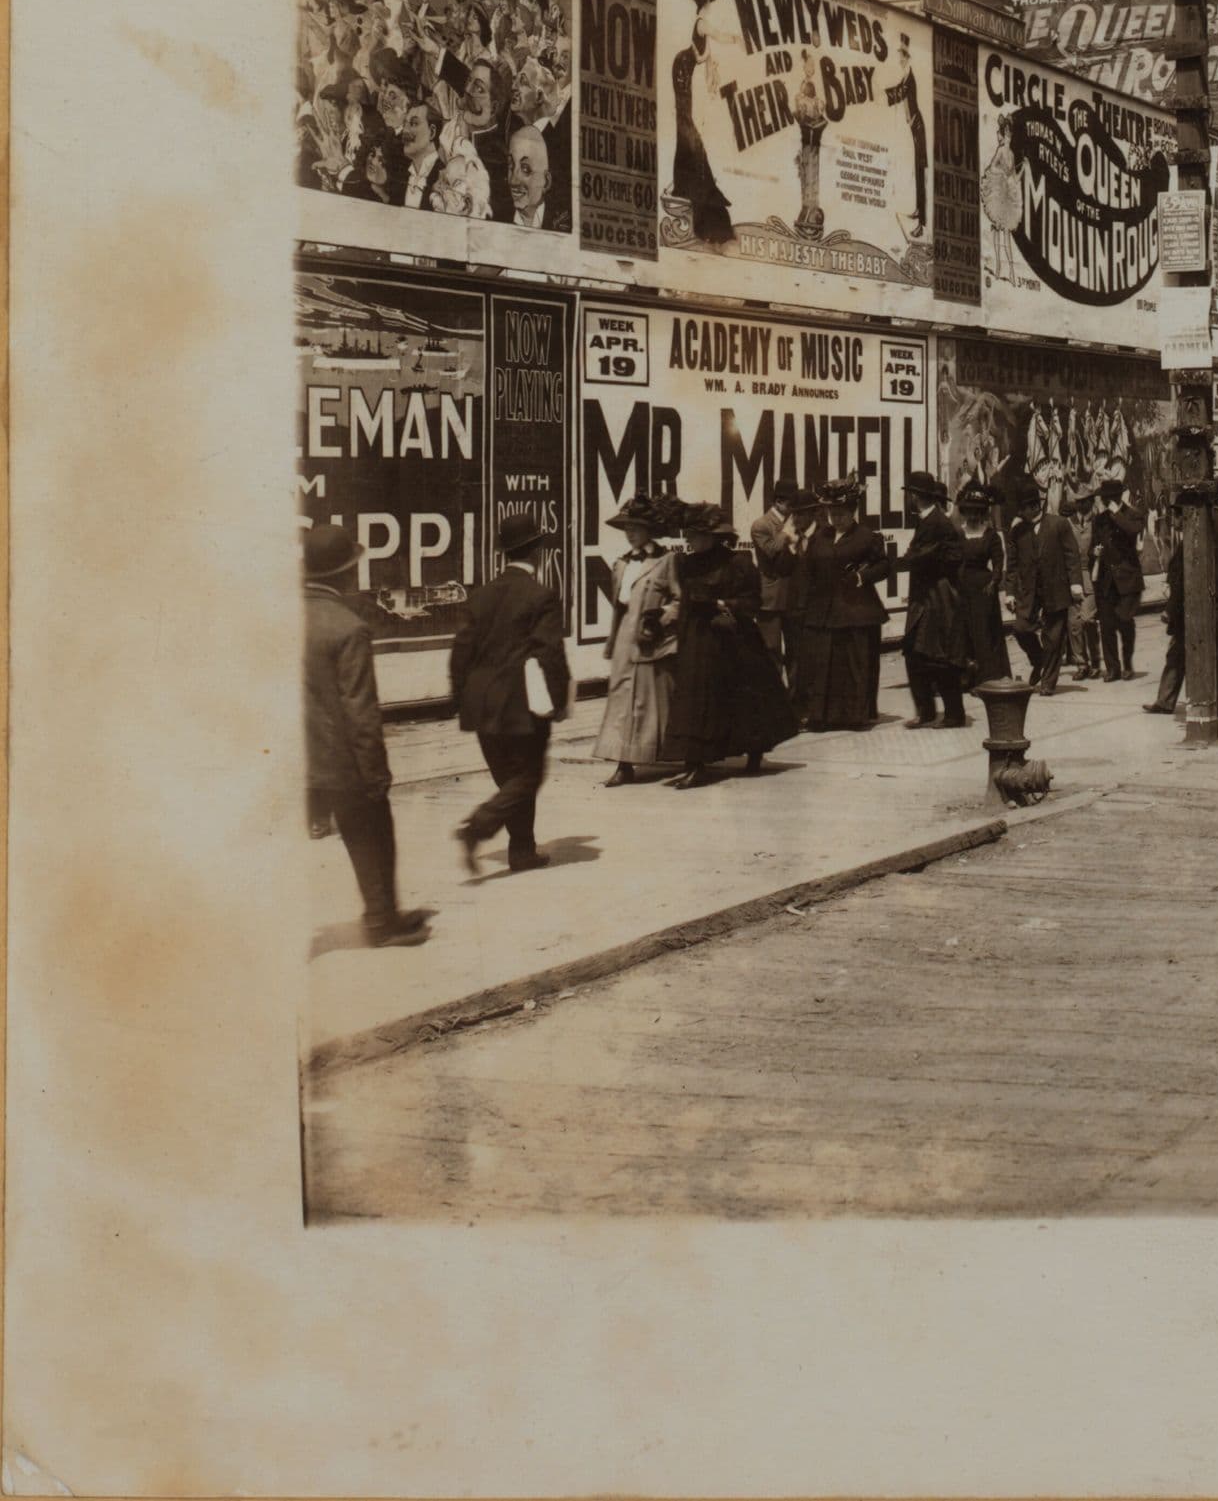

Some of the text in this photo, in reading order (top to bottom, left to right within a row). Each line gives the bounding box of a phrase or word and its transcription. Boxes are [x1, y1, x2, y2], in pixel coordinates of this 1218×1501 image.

[765, 50, 793, 76] AND
[581, 81, 657, 132] NEWLYWEDS
[719, 56, 875, 152] THEIR BABY
[984, 53, 1152, 152] CIRCLE THEATRE
[1025, 121, 1054, 145] THOMAS
[1073, 108, 1088, 132] THE
[581, 125, 656, 173] THEIR BABY
[858, 151, 874, 163] WEST
[1076, 132, 1141, 210] QUEEN
[582, 220, 657, 251] SUCCESS
[1024, 156, 1109, 295] MOULIN
[1111, 205, 1160, 292] ROUG
[740, 234, 887, 276] HIS MAJESTY THE BABY
[505, 310, 552, 365] NOW
[598, 318, 635, 333] WEEK
[589, 335, 644, 352] APR.
[670, 317, 863, 382] ACADEMY OF MUSIC
[889, 348, 914, 361] WEEK
[598, 356, 636, 377] 19
[884, 363, 921, 377] APR.
[495, 367, 563, 424] PLAYING
[704, 378, 727, 393] WM.
[734, 380, 745, 394] A.
[752, 381, 787, 396] BRADY
[889, 379, 914, 397] 19
[296, 385, 474, 460] EMAN
[505, 474, 550, 492] WITH
[582, 398, 916, 546] MR MANTELL
